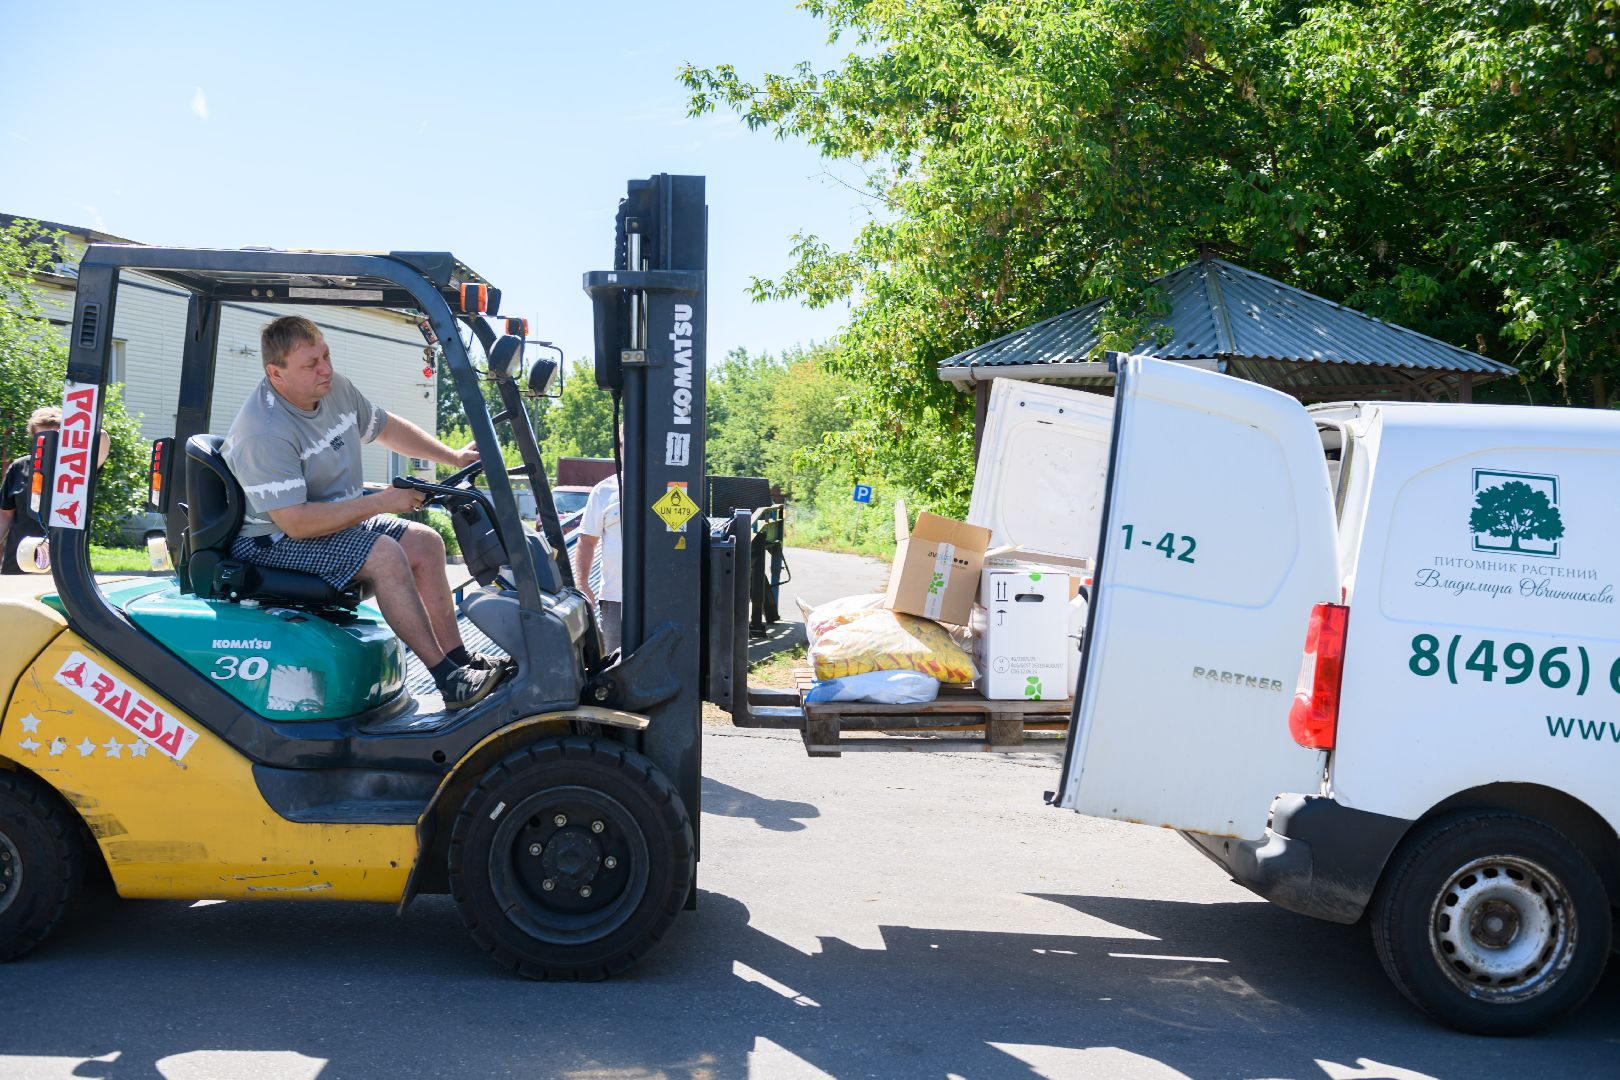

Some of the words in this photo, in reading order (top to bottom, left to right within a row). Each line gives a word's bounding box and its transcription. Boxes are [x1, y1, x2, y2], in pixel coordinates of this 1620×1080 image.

[669, 304, 693, 425] KOMATSU
[57, 388, 94, 494] RAESA
[857, 486, 869, 500] P
[660, 507, 671, 515] UN
[674, 508, 691, 516] 1479
[1121, 524, 1197, 564] 1-42
[1434, 556, 1517, 573] ПИТОМНИК
[1521, 564, 1598, 581] РАСТЕНИЙ
[1414, 568, 1513, 597] Владимира
[1519, 577, 1615, 605] Овчинникова
[212, 638, 272, 649] KOMATSU
[210, 655, 269, 681] 30
[1192, 666, 1283, 692] PARTNER
[1408, 633, 1590, 696] 8(496)
[90, 672, 185, 756] RAESA
